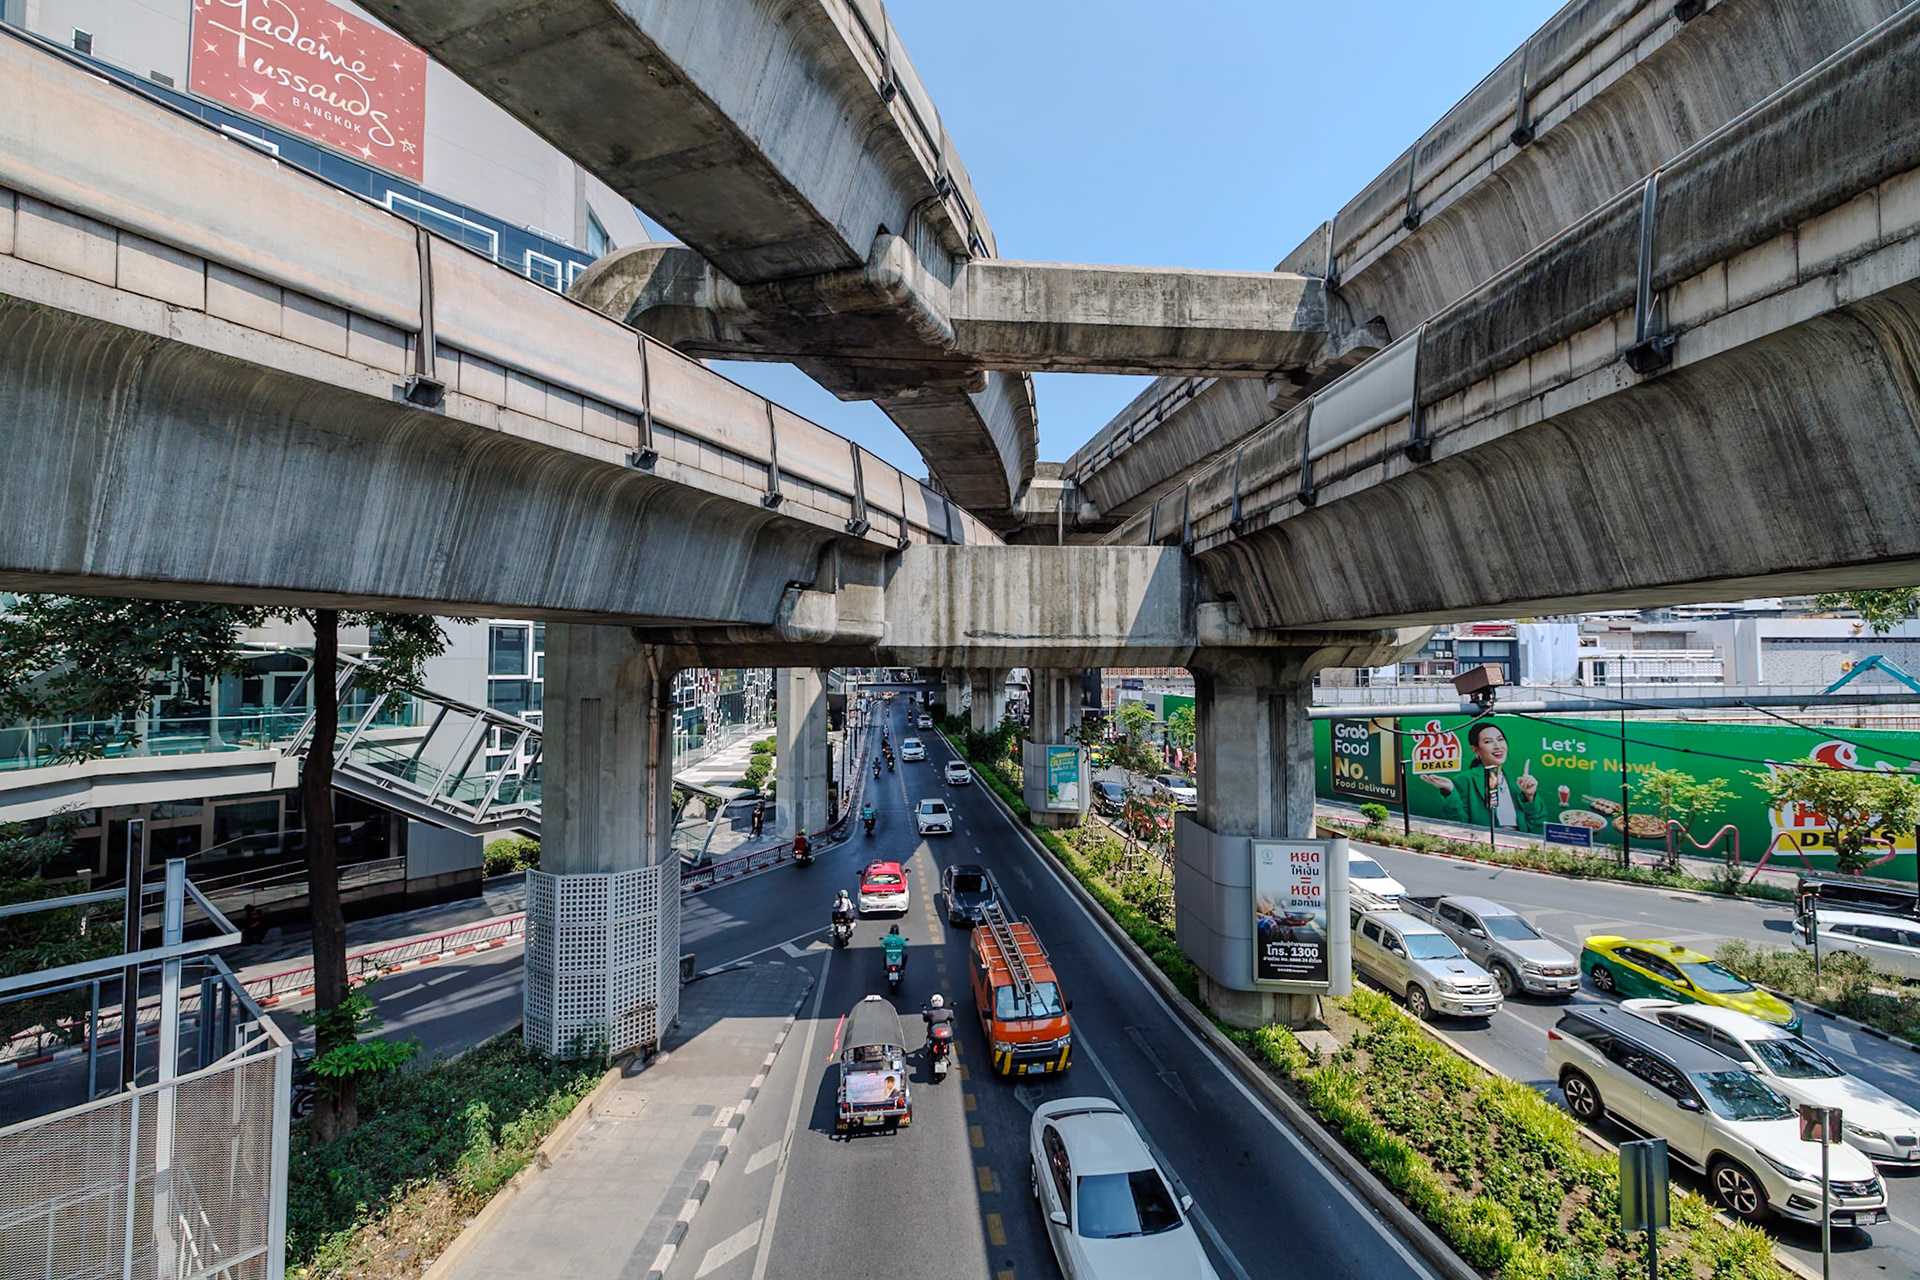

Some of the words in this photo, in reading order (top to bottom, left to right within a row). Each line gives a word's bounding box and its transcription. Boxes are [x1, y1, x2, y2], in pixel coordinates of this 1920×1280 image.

[207, 20, 395, 147] Tussauds
[293, 97, 361, 134] BANGKOK
[1335, 723, 1369, 740] Grab
[1334, 739, 1369, 756] Food
[1420, 746, 1456, 760] HOT
[1542, 737, 1587, 753] Let's
[1335, 756, 1369, 780] No.
[1421, 760, 1454, 770] DEALS
[1541, 753, 1598, 771] Order
[1335, 779, 1356, 789] Food
[1358, 782, 1396, 798] Delivery
[1290, 852, 1320, 866] หยุด
[1290, 864, 1320, 876] ให้เงิน
[1291, 885, 1321, 900] หยุด
[1291, 899, 1321, 907] ขอทาน
[1266, 943, 1289, 956] โทร.
[1290, 947, 1319, 958] 1300
